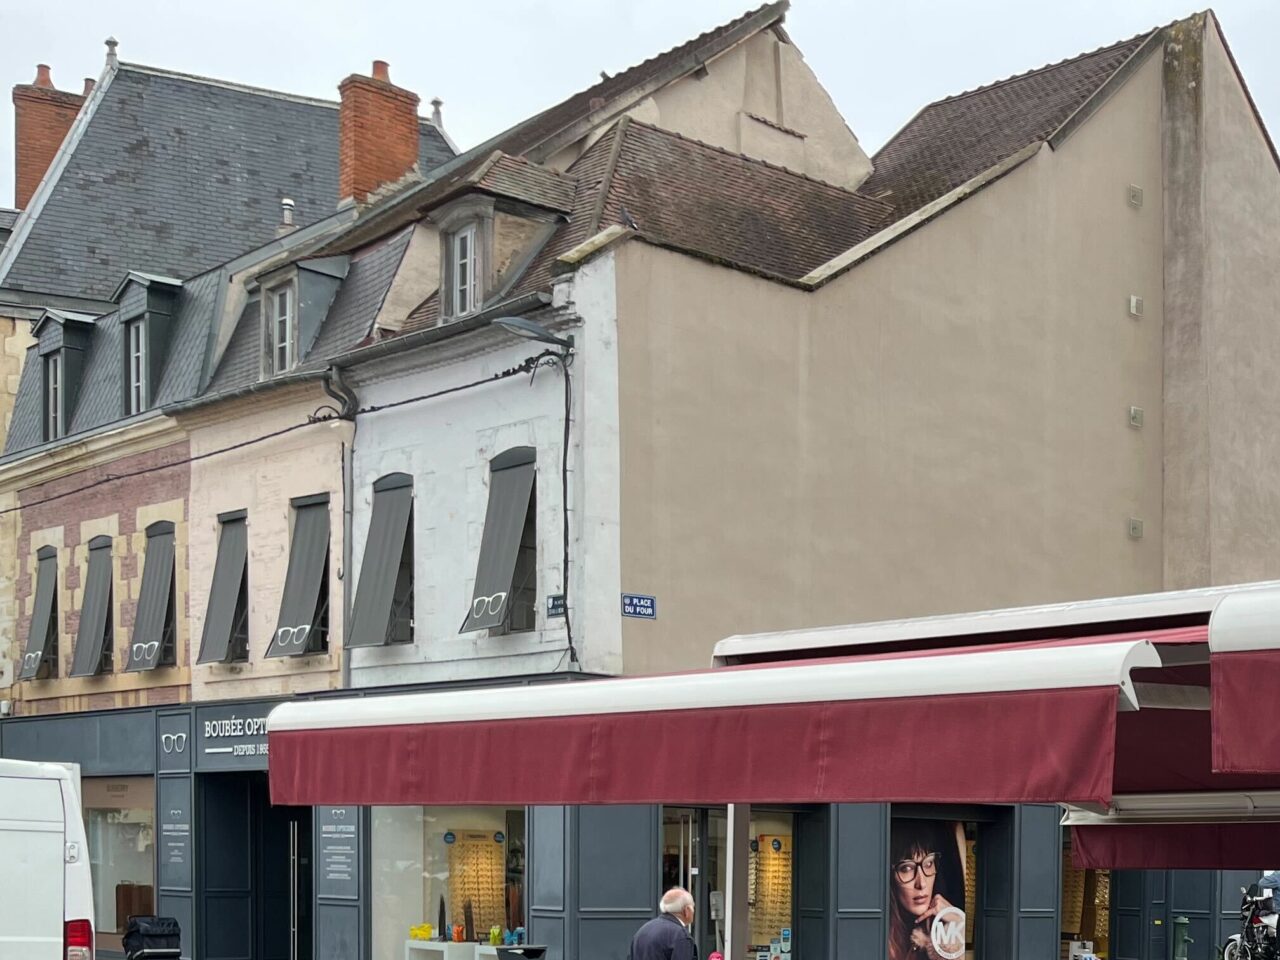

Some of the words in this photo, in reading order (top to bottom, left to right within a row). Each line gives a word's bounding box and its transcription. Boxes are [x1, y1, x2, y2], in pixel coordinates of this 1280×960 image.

[633, 598, 652, 607] PLACE
[625, 605, 634, 613] DU
[636, 607, 653, 615] FOUR
[205, 714, 244, 738] BOUBÉE
[234, 744, 256, 756] DEPUIS
